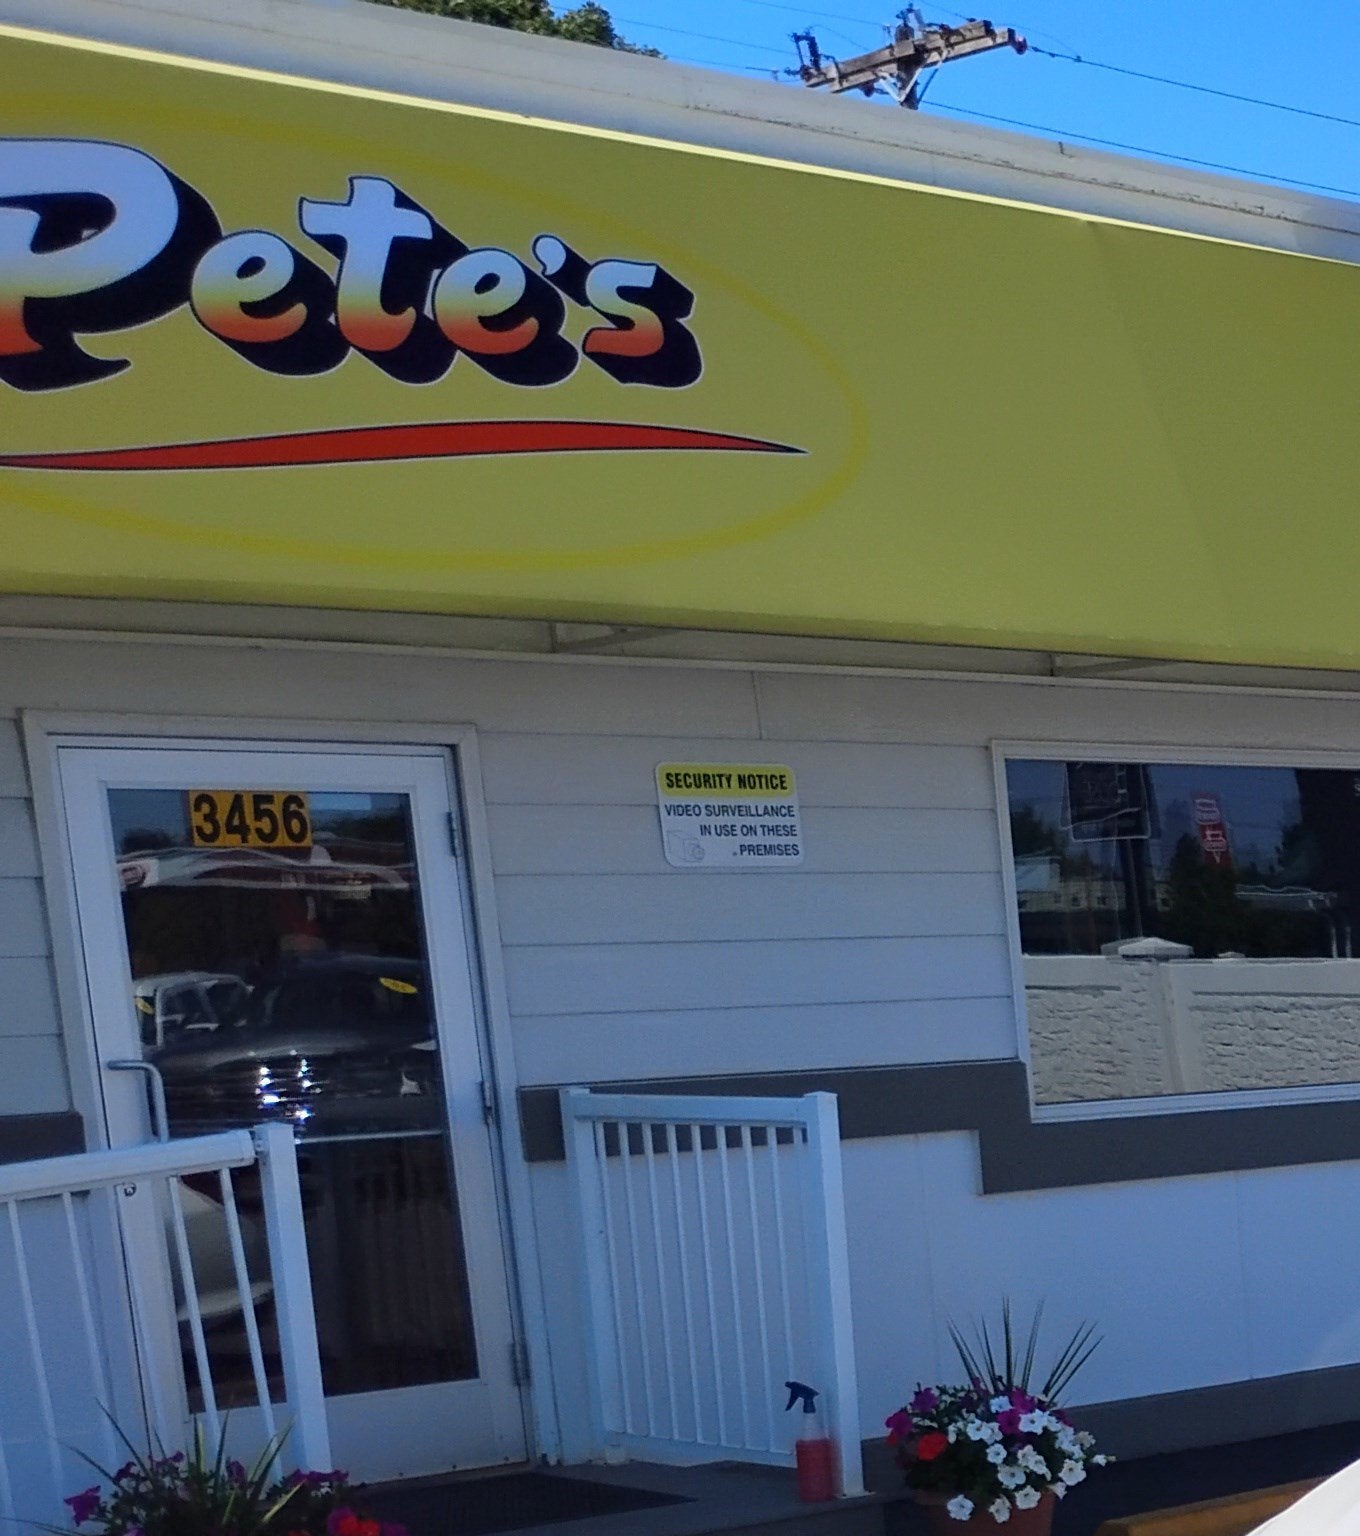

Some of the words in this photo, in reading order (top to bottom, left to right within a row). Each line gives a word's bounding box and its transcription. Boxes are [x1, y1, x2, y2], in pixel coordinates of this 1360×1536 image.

[0, 138, 703, 392] Pete's
[665, 772, 733, 790] SECURITY
[737, 773, 789, 791] NOTICE
[192, 792, 311, 844] 3456
[664, 804, 702, 818] VIDEO
[705, 804, 796, 819] SURVEILLANCE
[700, 824, 712, 837] IN
[714, 824, 739, 837] USE
[740, 824, 758, 838] ON
[760, 824, 798, 838] THESE
[739, 843, 800, 857] PREMISES
